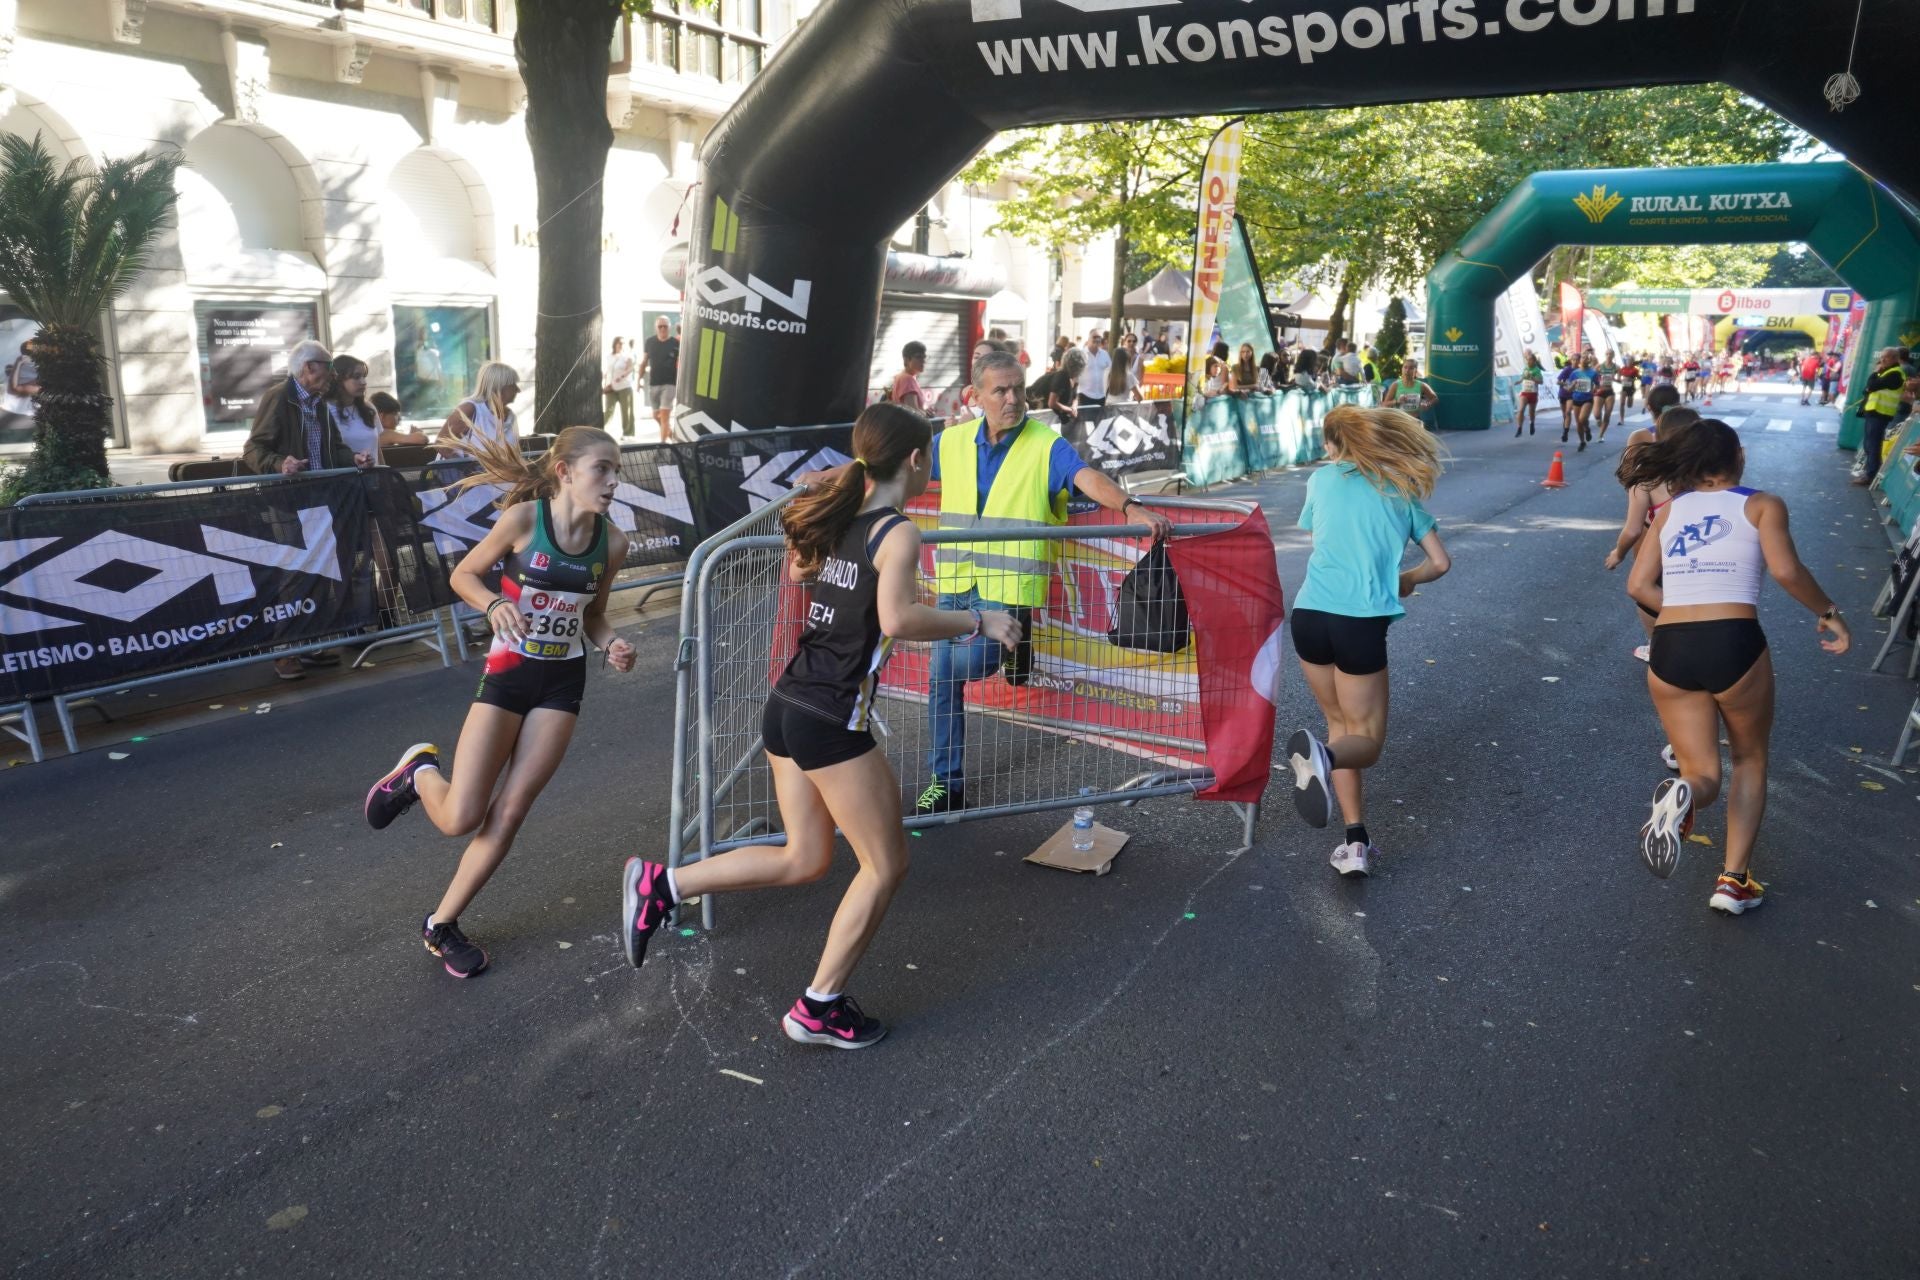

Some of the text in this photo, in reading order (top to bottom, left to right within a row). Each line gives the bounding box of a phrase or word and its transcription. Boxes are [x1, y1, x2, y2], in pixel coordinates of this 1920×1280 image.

[1630, 191, 1792, 213] RURAL KUTXA
[1629, 214, 1790, 226] GIZARTE EKINTZA ACCIÓN SOCIAL
[1197, 176, 1224, 303] ANETO
[1718, 290, 1771, 312] Bilbao
[1766, 316, 1795, 328] BM
[108, 612, 256, 657] BALONCESTO
[263, 598, 316, 624] REMO
[542, 643, 569, 656] BM
